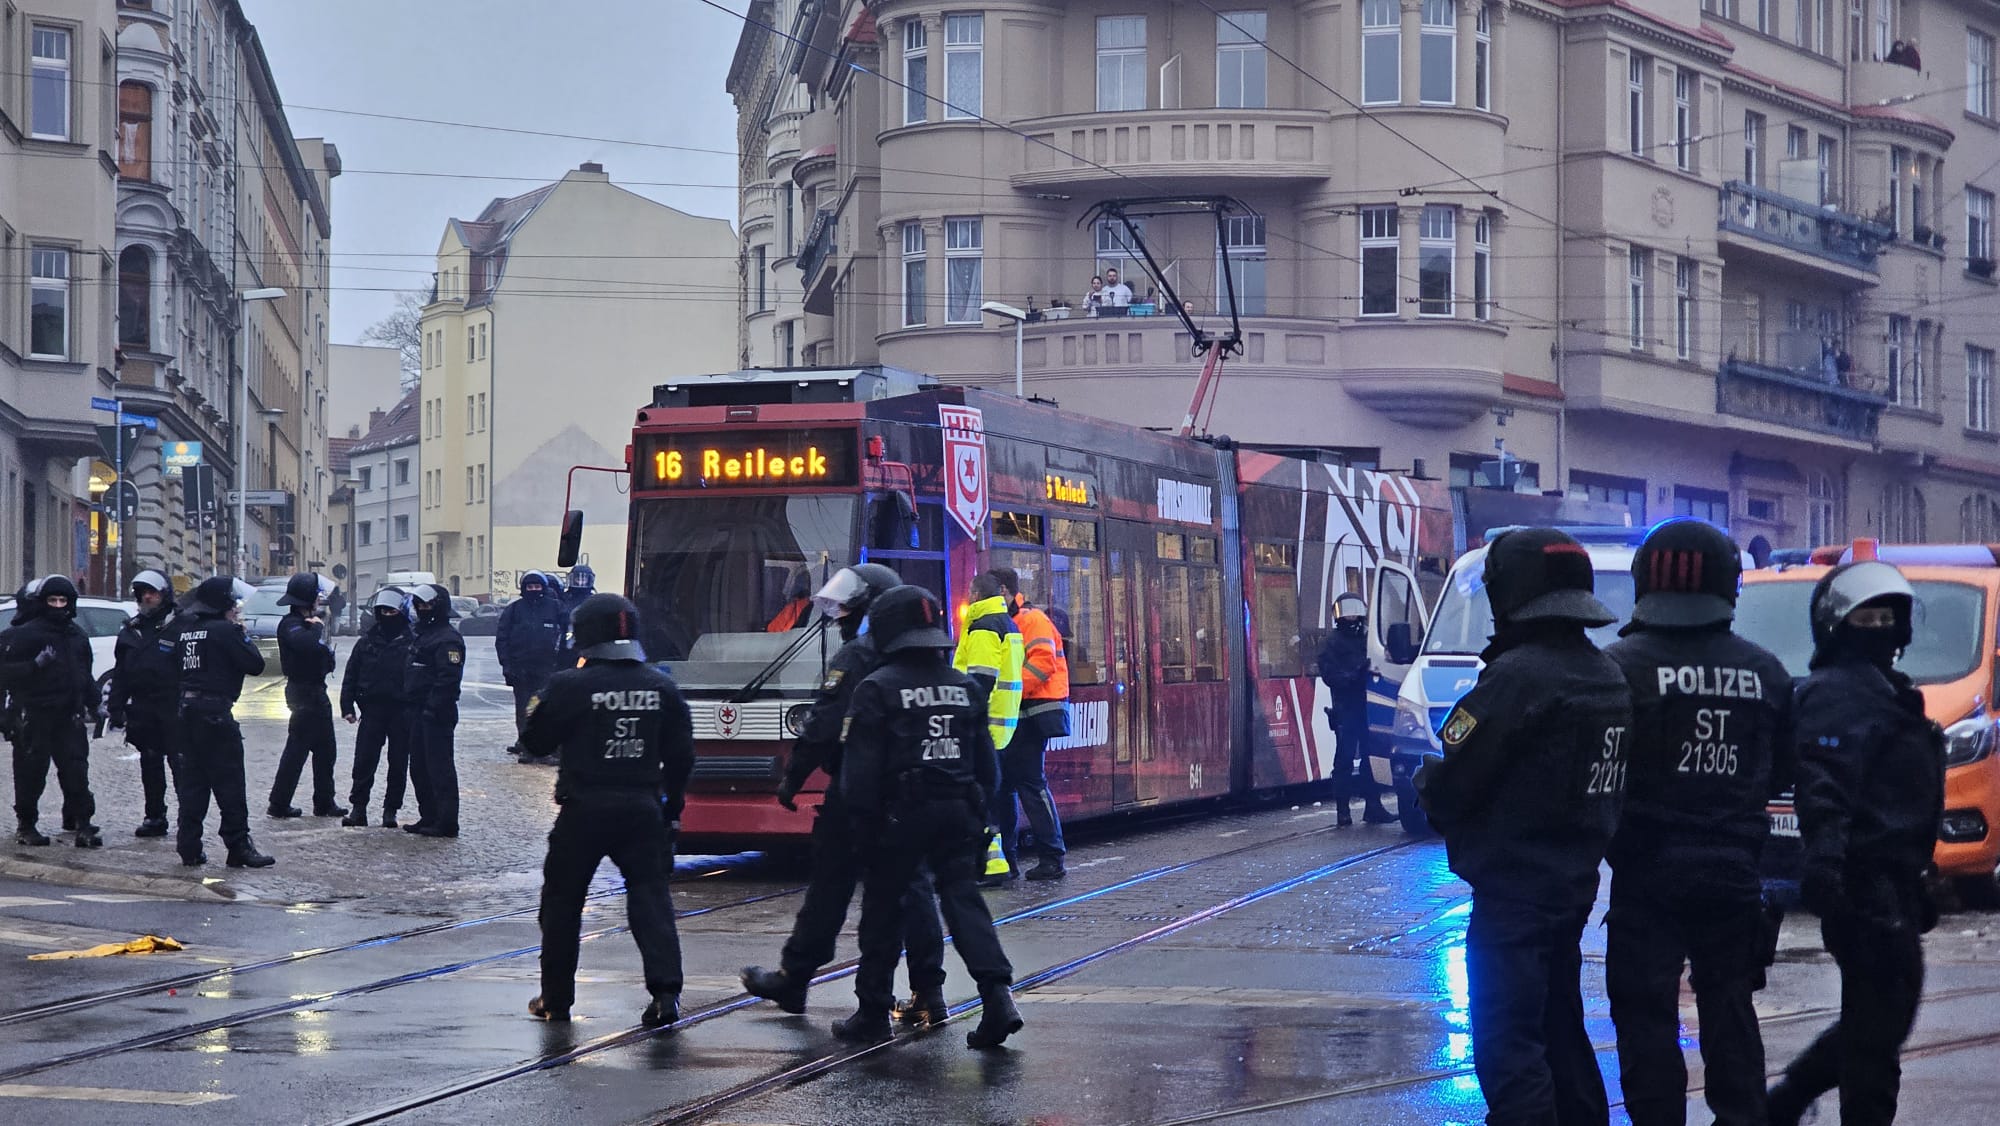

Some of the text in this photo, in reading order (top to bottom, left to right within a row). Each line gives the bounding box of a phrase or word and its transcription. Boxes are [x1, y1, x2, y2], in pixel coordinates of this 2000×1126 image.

[947, 415, 981, 441] HFC
[655, 446, 827, 479] 16 Reileck
[1054, 476, 1087, 504] Reileck
[180, 630, 207, 641] POLIZEI
[185, 641, 198, 655] ST
[183, 655, 201, 670] 21001
[1657, 666, 1763, 699] POLIZEI
[591, 690, 661, 711] POLIZEI
[899, 685, 970, 709] POLIZEI
[614, 717, 640, 737] ST
[928, 714, 955, 737] ST
[1694, 708, 1731, 741] ST
[1602, 726, 1625, 759] ST
[1677, 742, 1739, 776] 21305
[1189, 764, 1203, 789] 641
[1586, 761, 1627, 794] 21211
